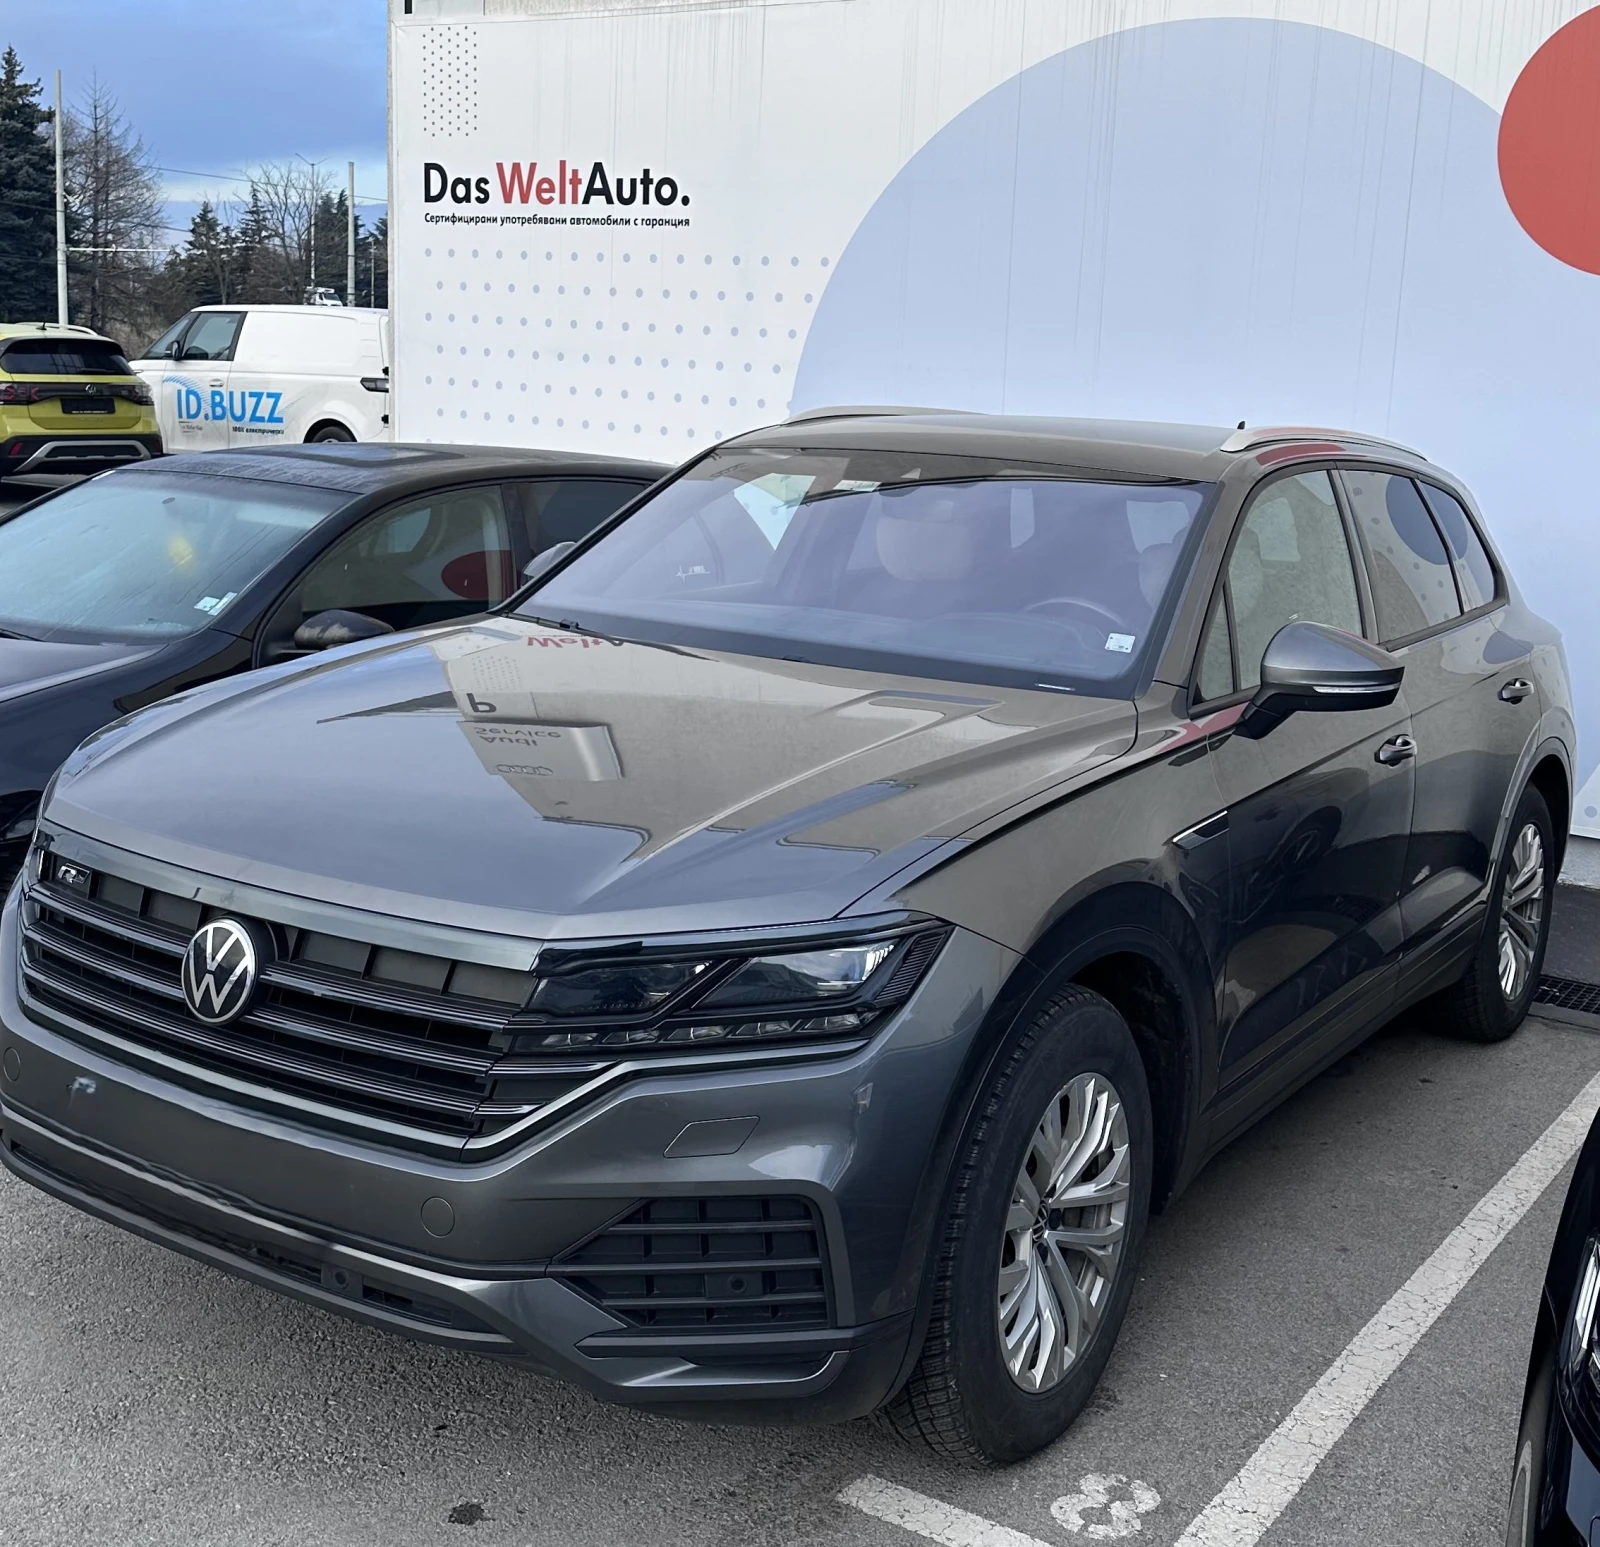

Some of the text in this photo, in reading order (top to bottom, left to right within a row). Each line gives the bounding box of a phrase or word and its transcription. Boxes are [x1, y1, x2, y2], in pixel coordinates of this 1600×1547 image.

[424, 160, 690, 206] Das WeltAuto.
[424, 212, 690, 229] Сертифицирани употребявани автомобили с гаранция
[177, 389, 284, 423] ID.BUZZ
